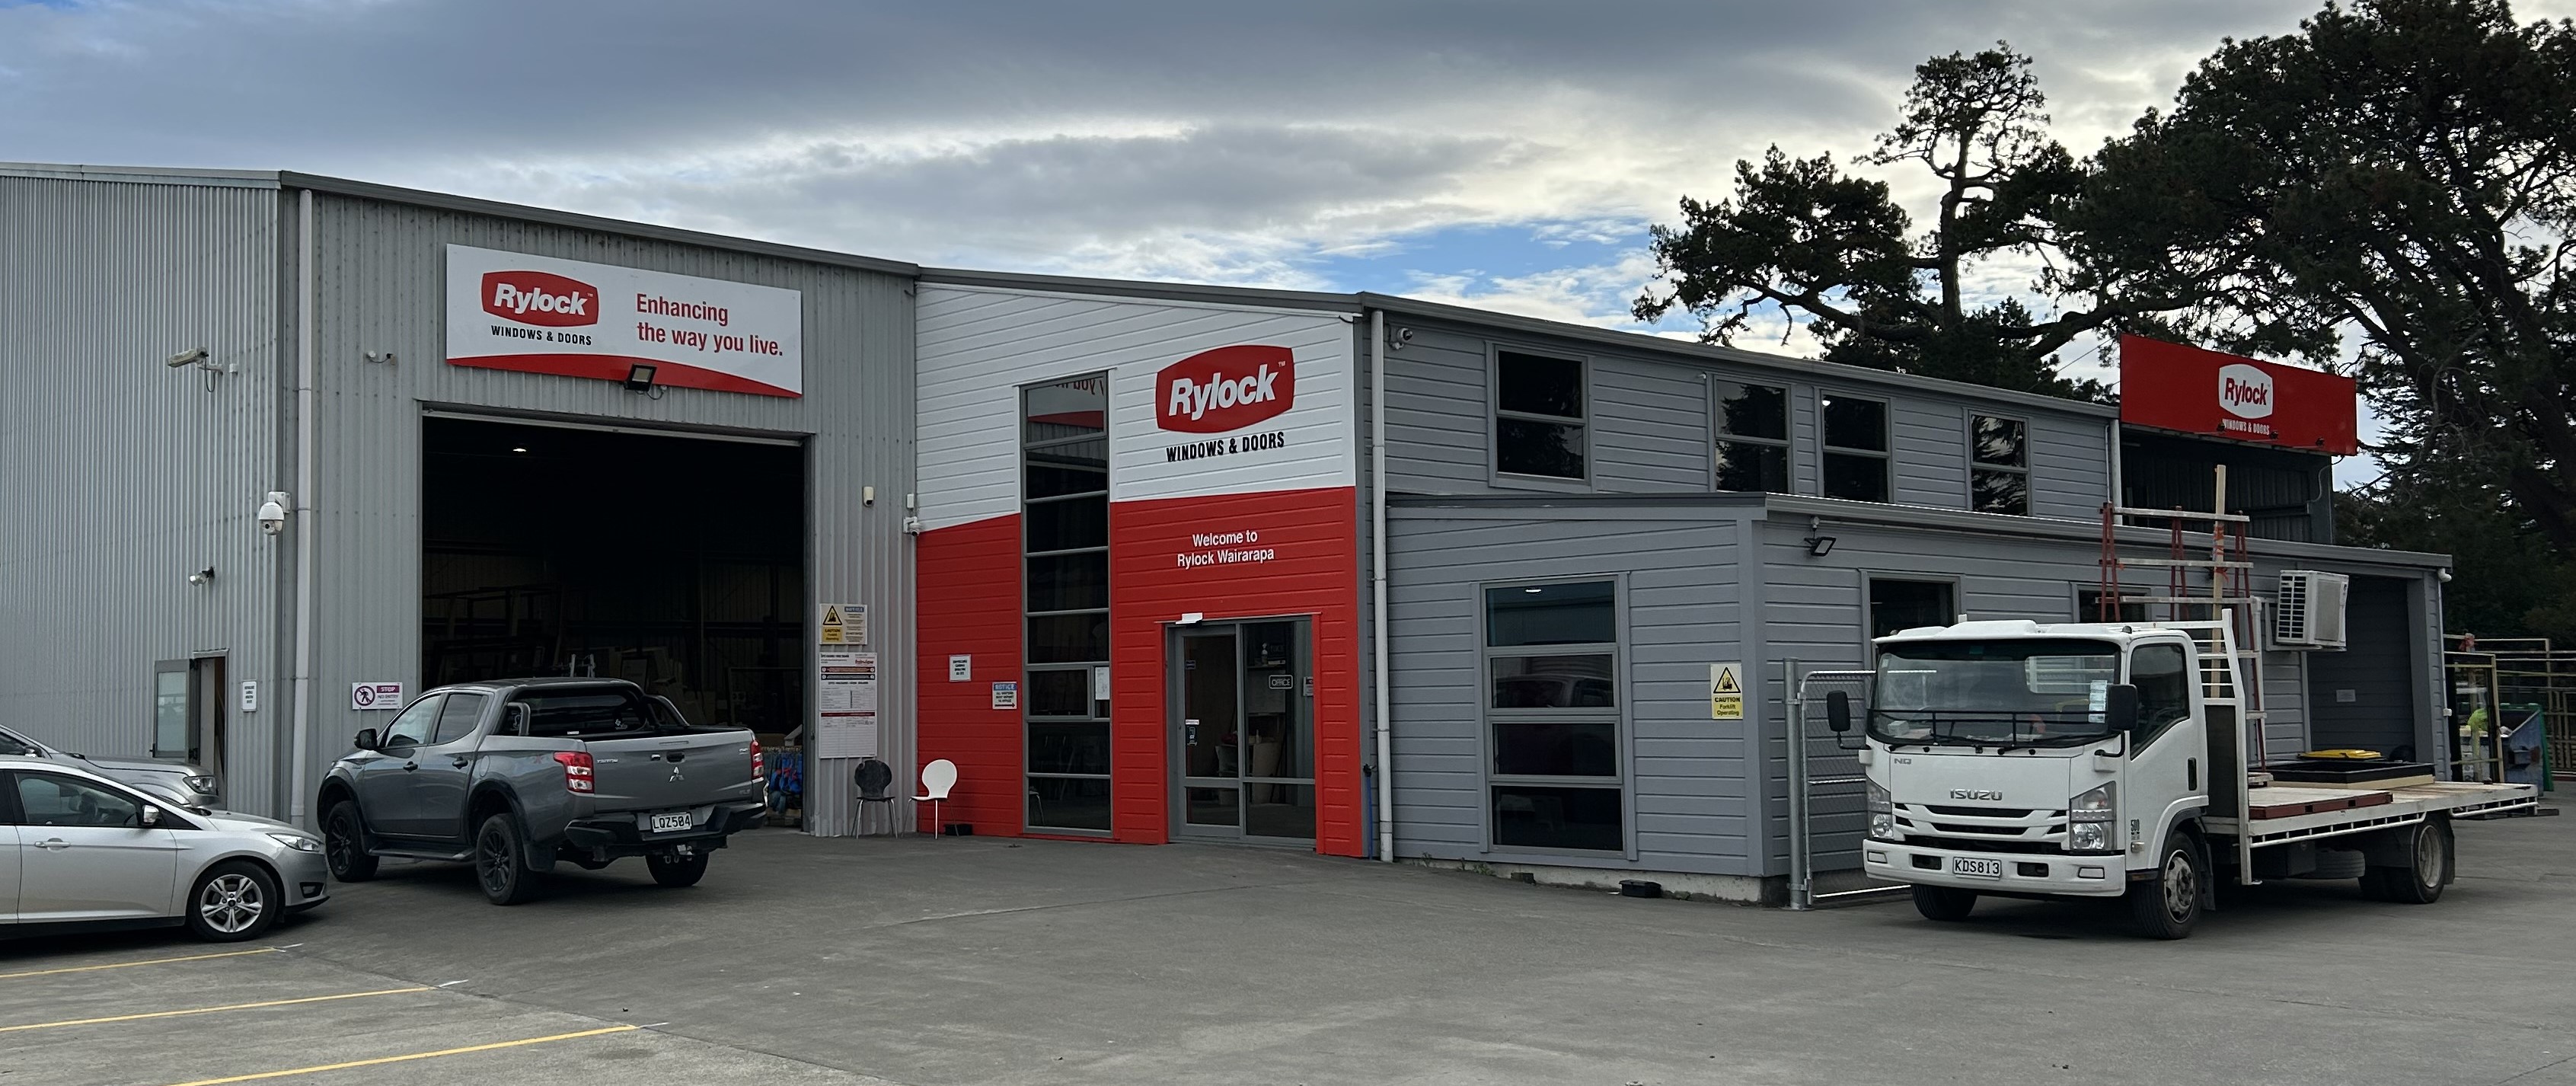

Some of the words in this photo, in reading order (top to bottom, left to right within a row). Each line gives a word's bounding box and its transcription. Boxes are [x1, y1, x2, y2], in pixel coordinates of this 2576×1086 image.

[494, 283, 588, 315] Rylock
[637, 293, 728, 327] Enhancing
[491, 325, 542, 340] WINDOWS
[547, 331, 554, 341] &
[558, 332, 592, 346] DOORS
[637, 321, 666, 343] the
[672, 329, 707, 351] way
[713, 334, 743, 353] you
[750, 334, 783, 356] live.
[1169, 364, 1278, 421] Rylock
[2225, 377, 2268, 406] Rylock
[2223, 418, 2247, 432] WINDOWS
[2247, 422, 2252, 433] &
[2253, 423, 2270, 436] DOORS
[1167, 439, 1224, 462] WINDOWS
[1229, 438, 1237, 454] &
[1243, 431, 1285, 452] DOORS
[1192, 532, 1243, 547] Welcome
[1246, 529, 1258, 542] to
[1177, 551, 1215, 570] Rylock
[1218, 548, 1275, 564] Wairarapa
[1950, 789, 2003, 801] ISUZU
[1955, 859, 2000, 874] KDS813
